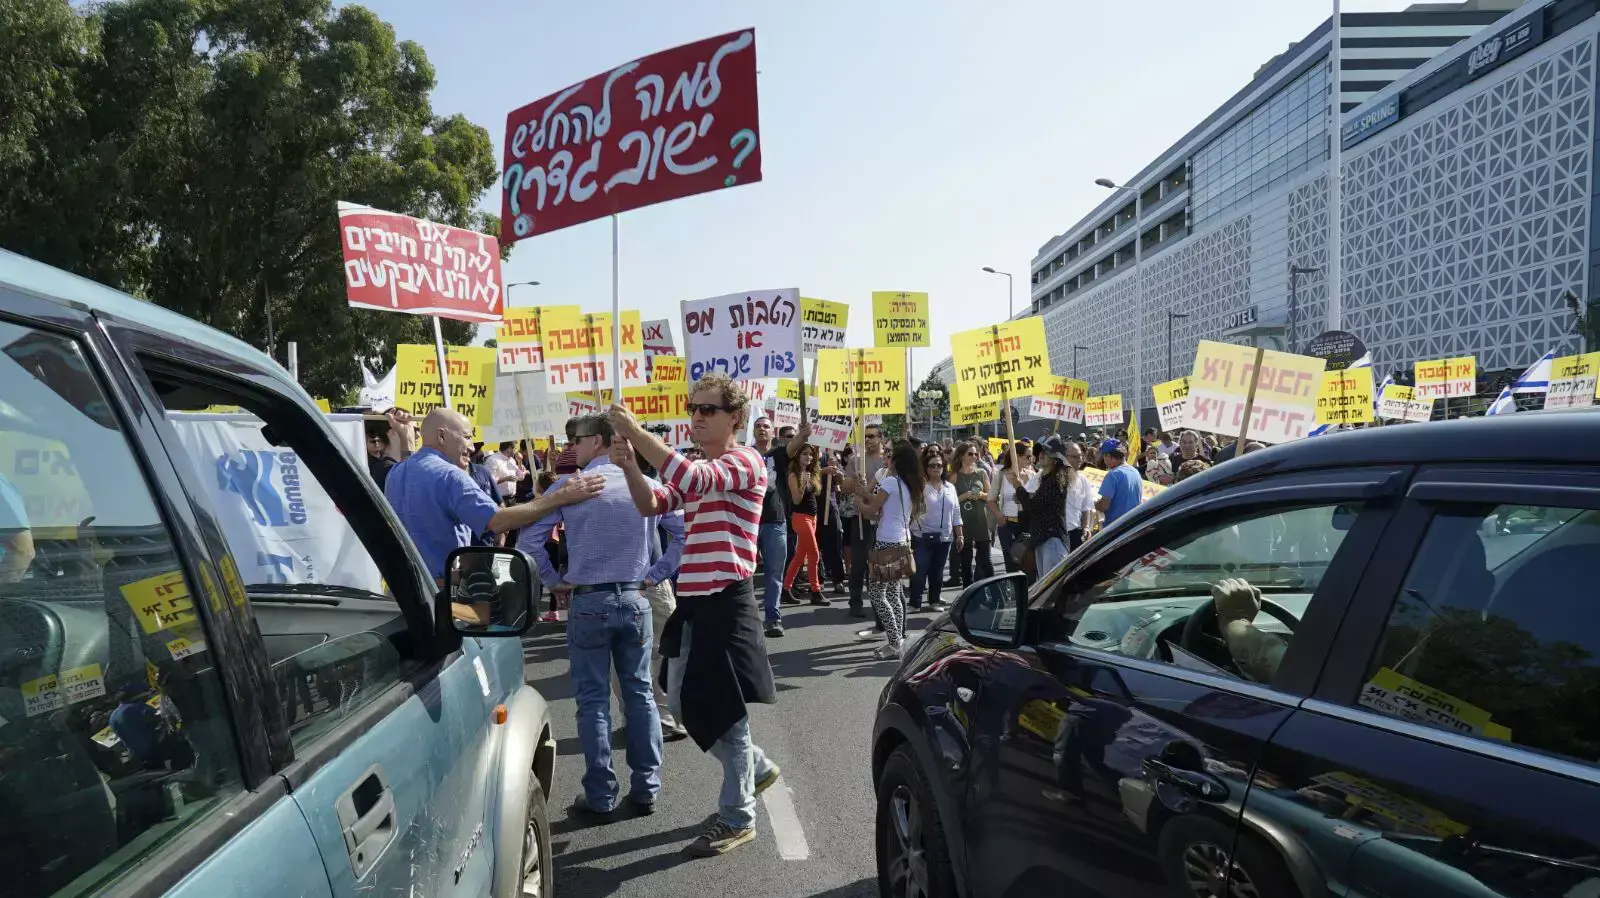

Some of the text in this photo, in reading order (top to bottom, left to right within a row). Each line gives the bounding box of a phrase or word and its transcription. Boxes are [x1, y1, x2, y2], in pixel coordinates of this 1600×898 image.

[511, 31, 753, 158] למה להחליש
[1360, 102, 1397, 131] SPRING
[603, 112, 718, 194] ישוב
[416, 221, 450, 245] אם
[344, 225, 492, 274] לא הינו חייבים
[345, 252, 436, 308] מבקשים
[472, 268, 500, 312] לא
[804, 309, 837, 325] הטבות!
[876, 318, 927, 330] אל תפסיקו לנו
[1224, 309, 1254, 328] HOTEL
[548, 326, 603, 352] הטבה
[820, 329, 834, 341] לא
[836, 331, 845, 342] או
[886, 332, 922, 344] את החמצן
[975, 334, 1022, 358] נהריה:
[502, 345, 544, 365] הריה
[550, 361, 606, 385] נהריה
[654, 365, 682, 382] הטבה
[961, 354, 1042, 382] אל תפסיקו לנו
[1418, 364, 1471, 379] אין הטבה
[400, 380, 416, 396] לנו
[469, 383, 487, 399] אל
[750, 380, 765, 400] אין
[824, 380, 839, 393] לנו
[884, 379, 900, 392] אל
[976, 374, 1035, 400] את החמצן
[1169, 385, 1189, 400] בות!
[1327, 378, 1357, 392] נהריה:
[1418, 380, 1471, 397] אין נהריה
[874, 396, 891, 408] את
[1071, 387, 1085, 401] אין
[1317, 394, 1369, 408] אל תפסיקו לנו
[1033, 399, 1081, 420] אין נהריה
[1086, 400, 1120, 412] אין הטבה
[1109, 413, 1121, 422] אין
[1326, 408, 1363, 421] את החמצן
